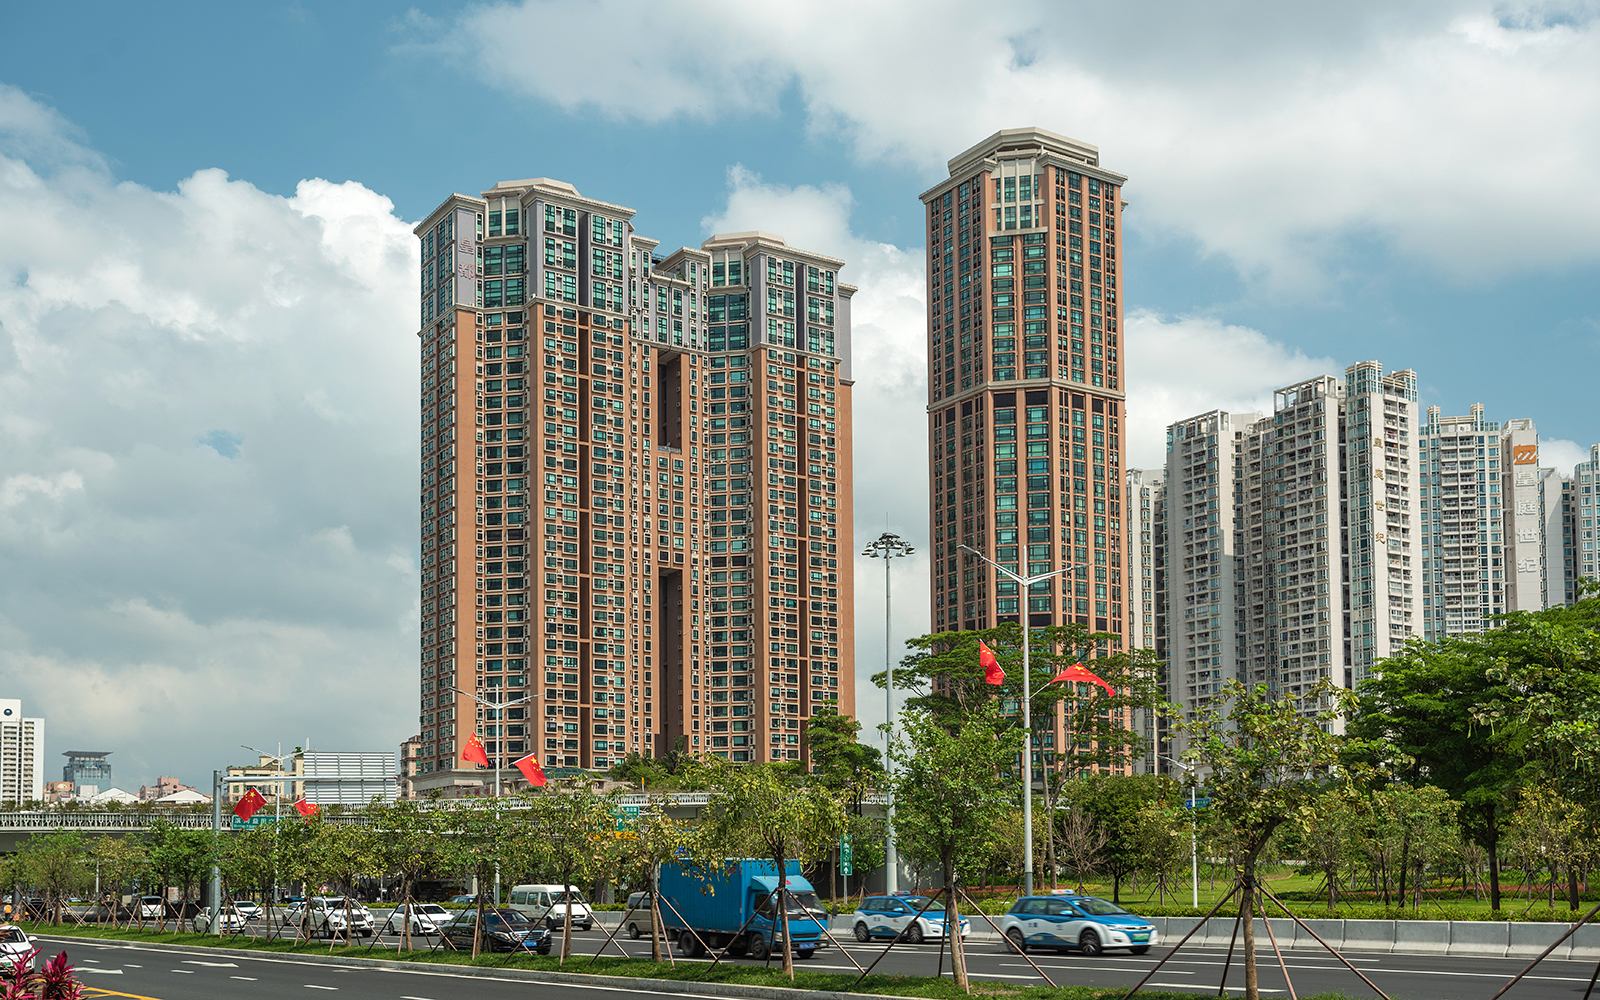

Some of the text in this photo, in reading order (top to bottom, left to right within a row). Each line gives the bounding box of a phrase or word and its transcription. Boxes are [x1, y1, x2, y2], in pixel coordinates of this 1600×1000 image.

[1373, 437, 1386, 545] 皇庭世纪
[1515, 471, 1538, 574] 皇庭世纪
